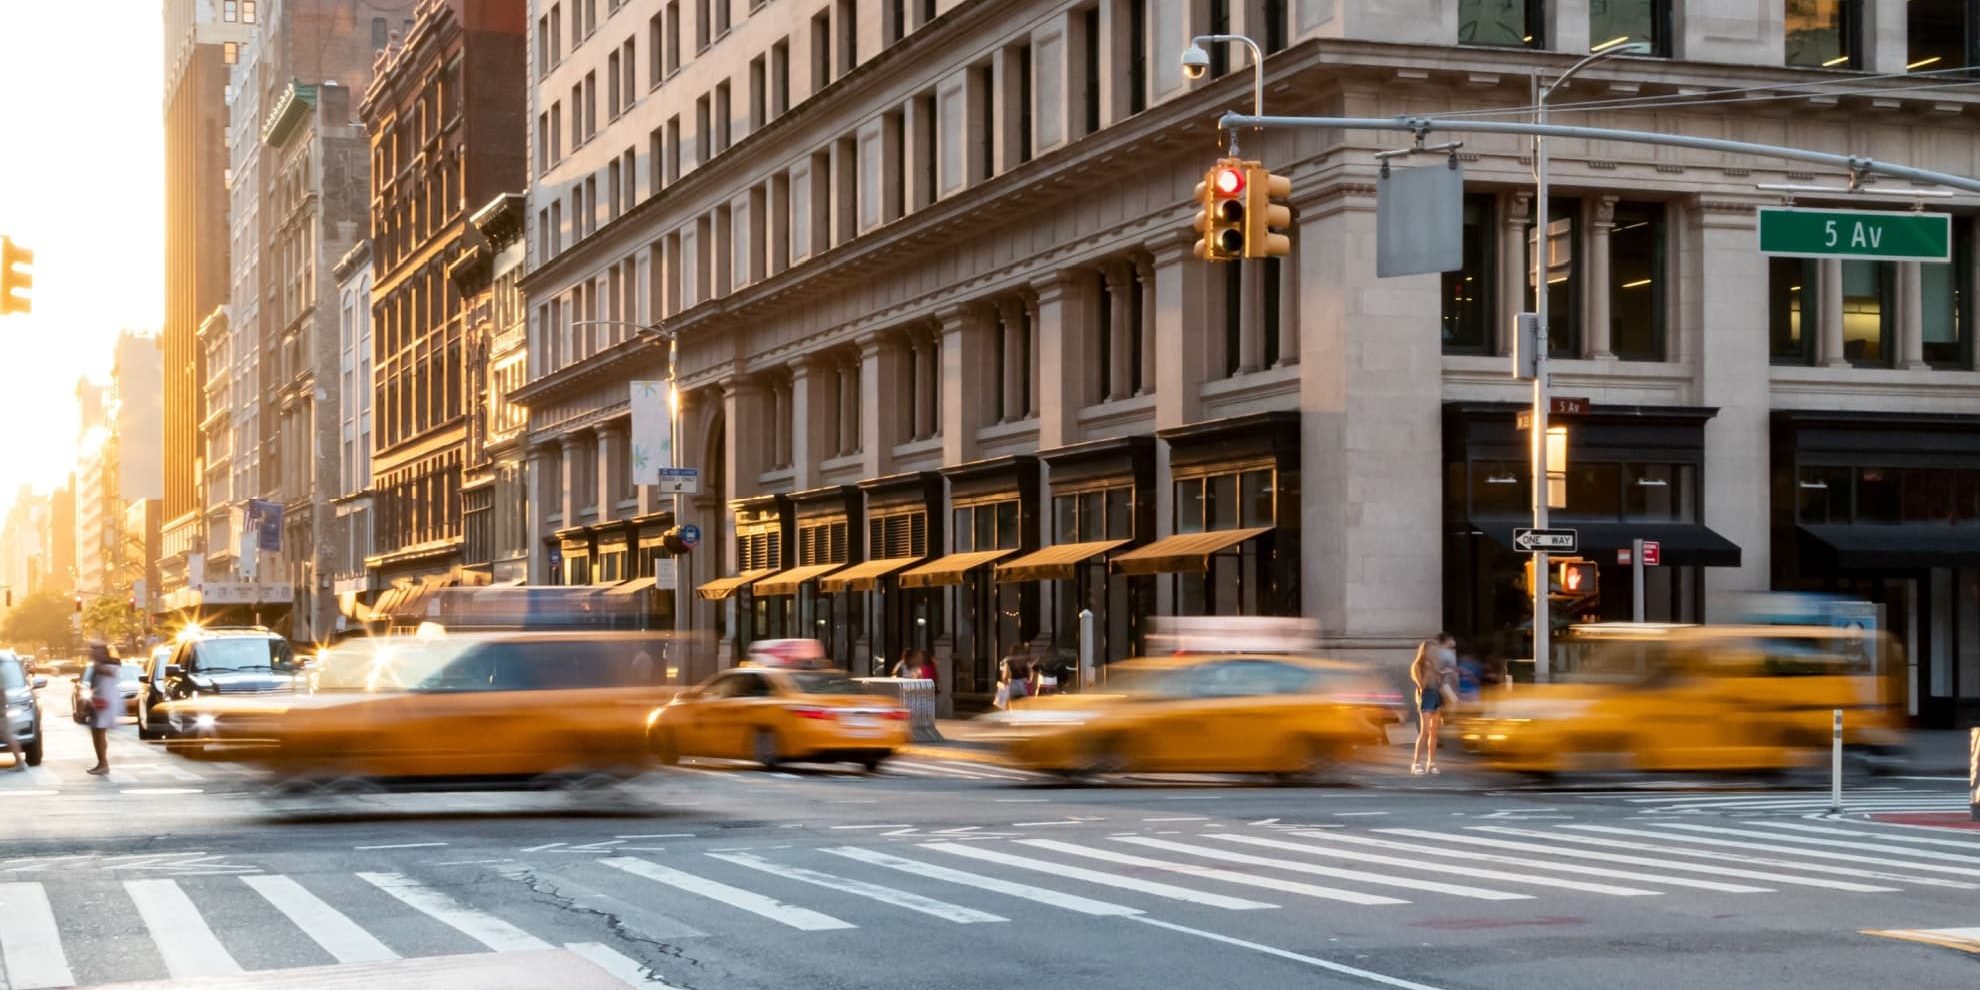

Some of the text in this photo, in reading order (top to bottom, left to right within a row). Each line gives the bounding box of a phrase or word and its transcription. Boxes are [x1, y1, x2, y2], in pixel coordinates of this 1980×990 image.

[1825, 220, 1882, 248] 5 Av
[1560, 401, 1580, 413] 5 Av
[1522, 535, 1570, 545] ONE WAY
